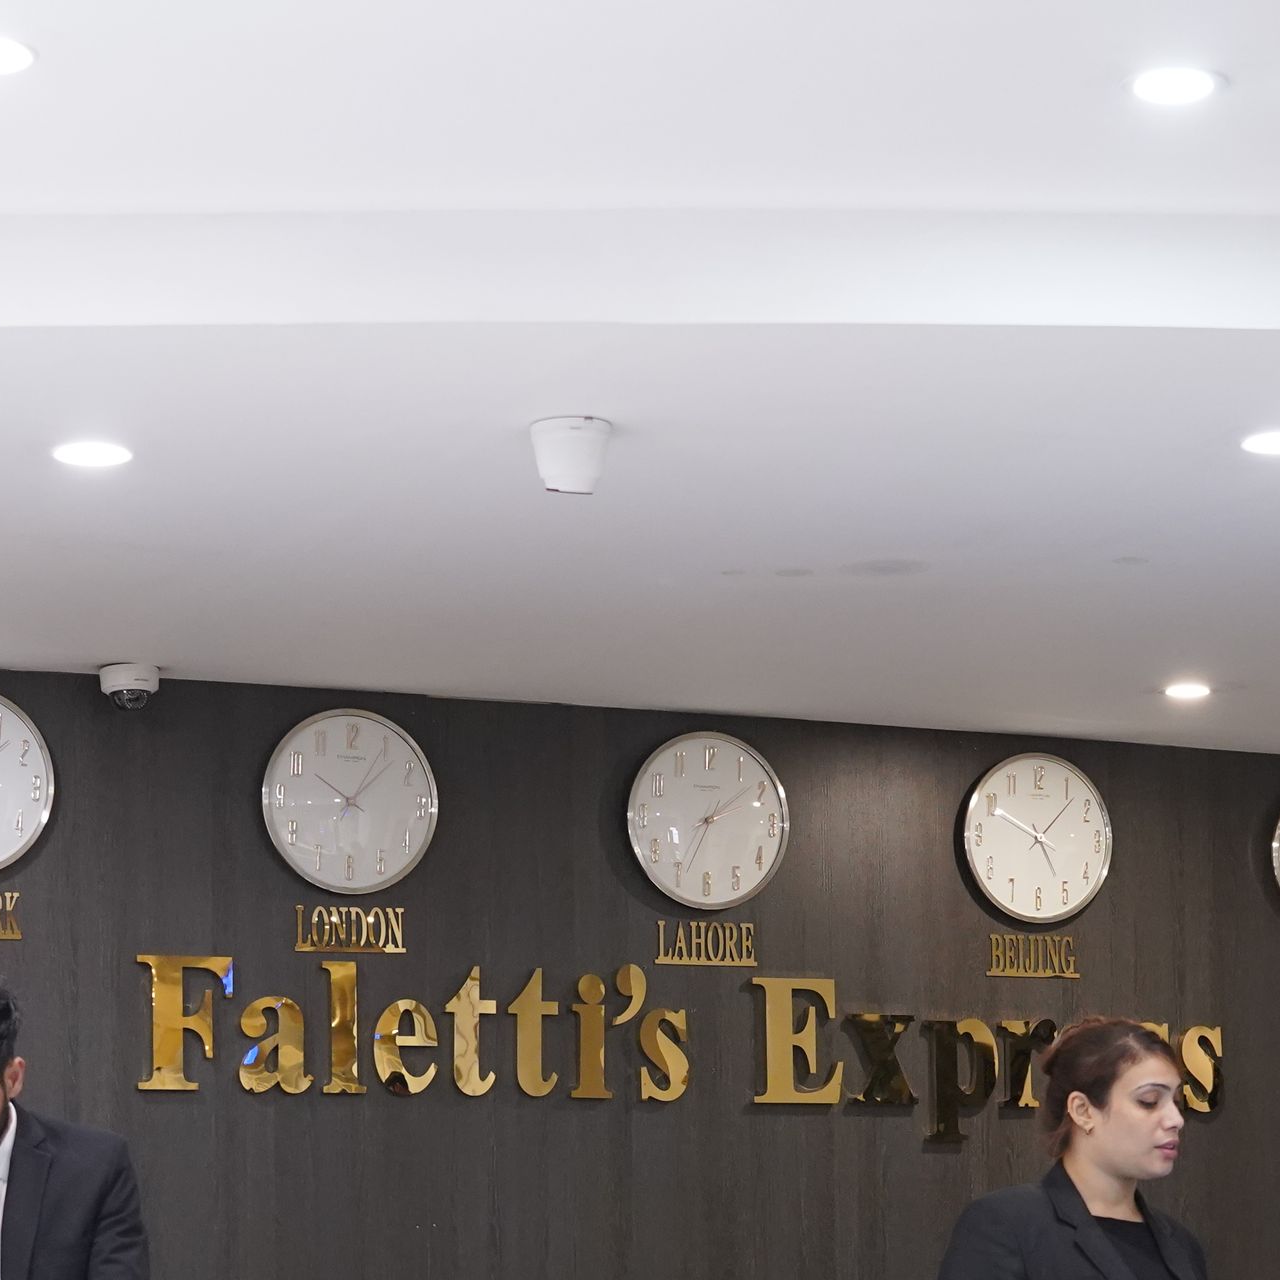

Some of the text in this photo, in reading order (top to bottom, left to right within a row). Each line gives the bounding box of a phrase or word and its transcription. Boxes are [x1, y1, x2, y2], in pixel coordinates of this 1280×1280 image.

[295, 904, 406, 951] LONDON
[656, 920, 756, 963] LAHORE
[989, 934, 1076, 975] BEIJING
[136, 953, 1224, 1143] Faletti's Exprs
